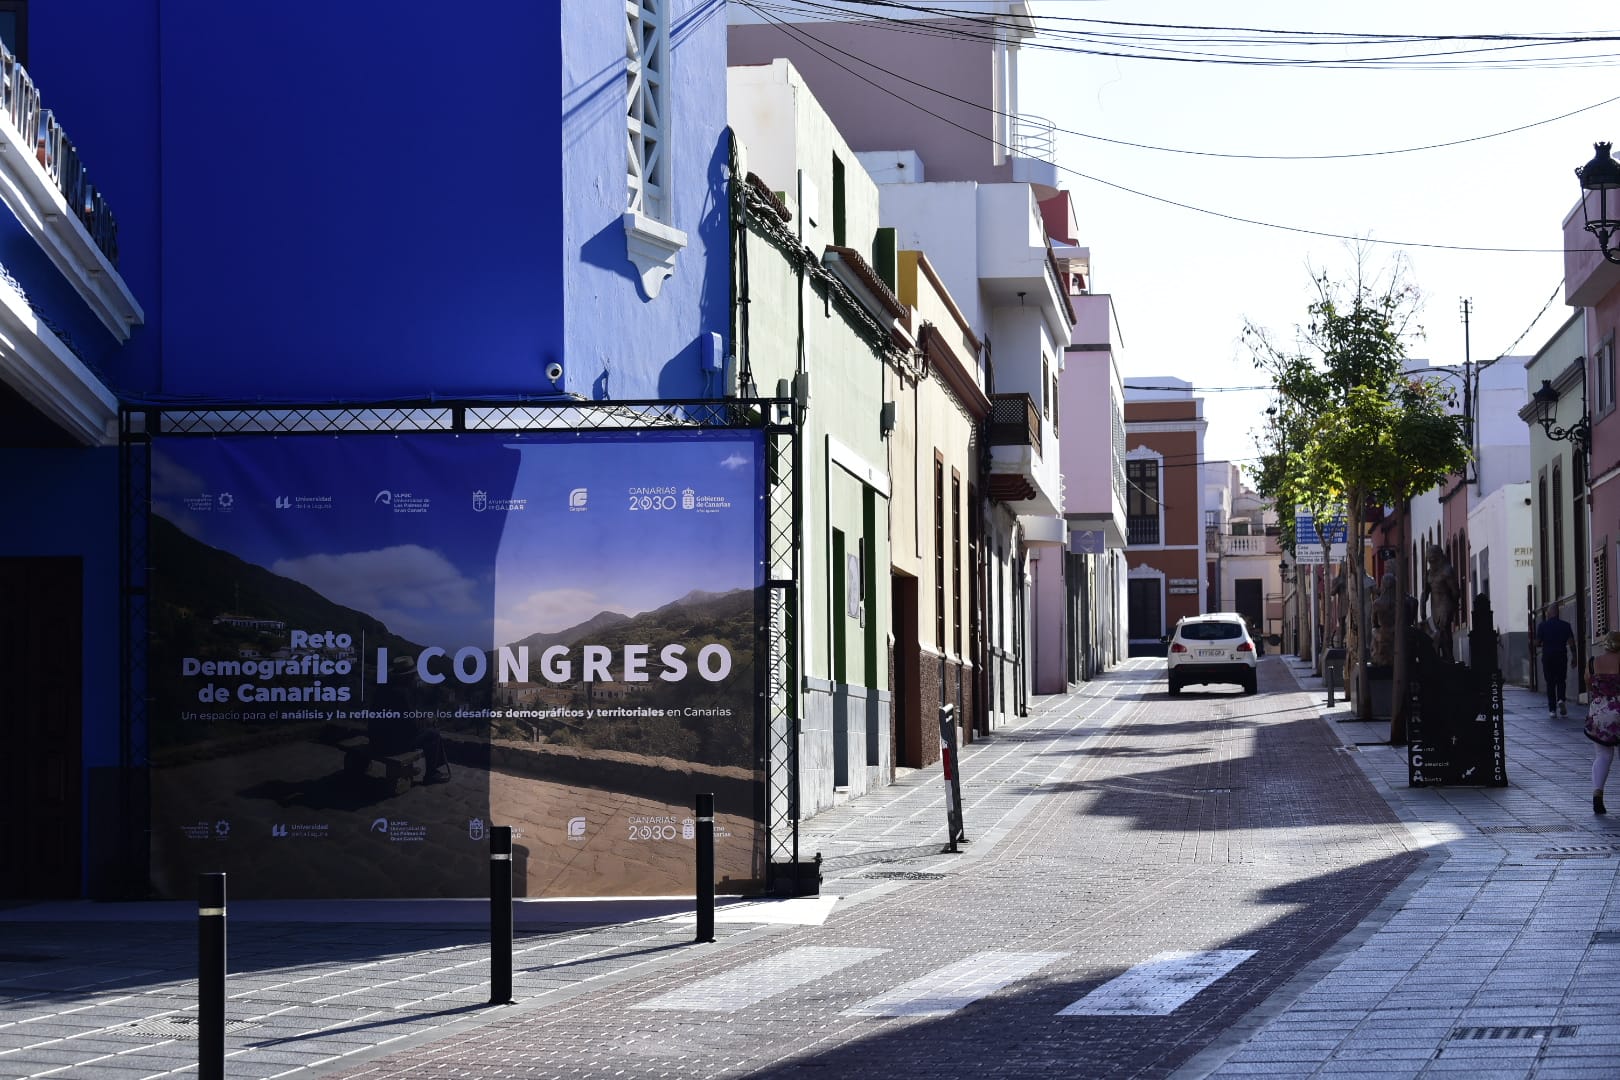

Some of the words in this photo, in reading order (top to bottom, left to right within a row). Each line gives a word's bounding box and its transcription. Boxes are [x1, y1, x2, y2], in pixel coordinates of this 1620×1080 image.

[629, 496, 677, 510] 2030
[290, 629, 352, 649] Reto
[182, 654, 352, 680] Demográfico
[376, 647, 388, 684] I
[416, 643, 732, 684] CONGRESO
[198, 683, 230, 703] de
[237, 680, 351, 703] Canarias
[181, 711, 197, 720] Un
[199, 710, 240, 721] espacio
[243, 712, 266, 721] para
[269, 710, 278, 720] el
[281, 709, 323, 719] análisis
[326, 711, 333, 721] y
[337, 709, 347, 719] la
[349, 709, 401, 719] reflexión
[403, 709, 433, 719] sobre
[437, 709, 452, 718] los
[454, 708, 503, 718] desafíos
[505, 707, 584, 719] demográficos
[587, 709, 594, 719] y
[596, 706, 664, 717] territoriales
[667, 709, 681, 717] en
[683, 707, 732, 717] Canarias
[629, 816, 677, 824] CANARIAS
[629, 825, 676, 840] 2030
